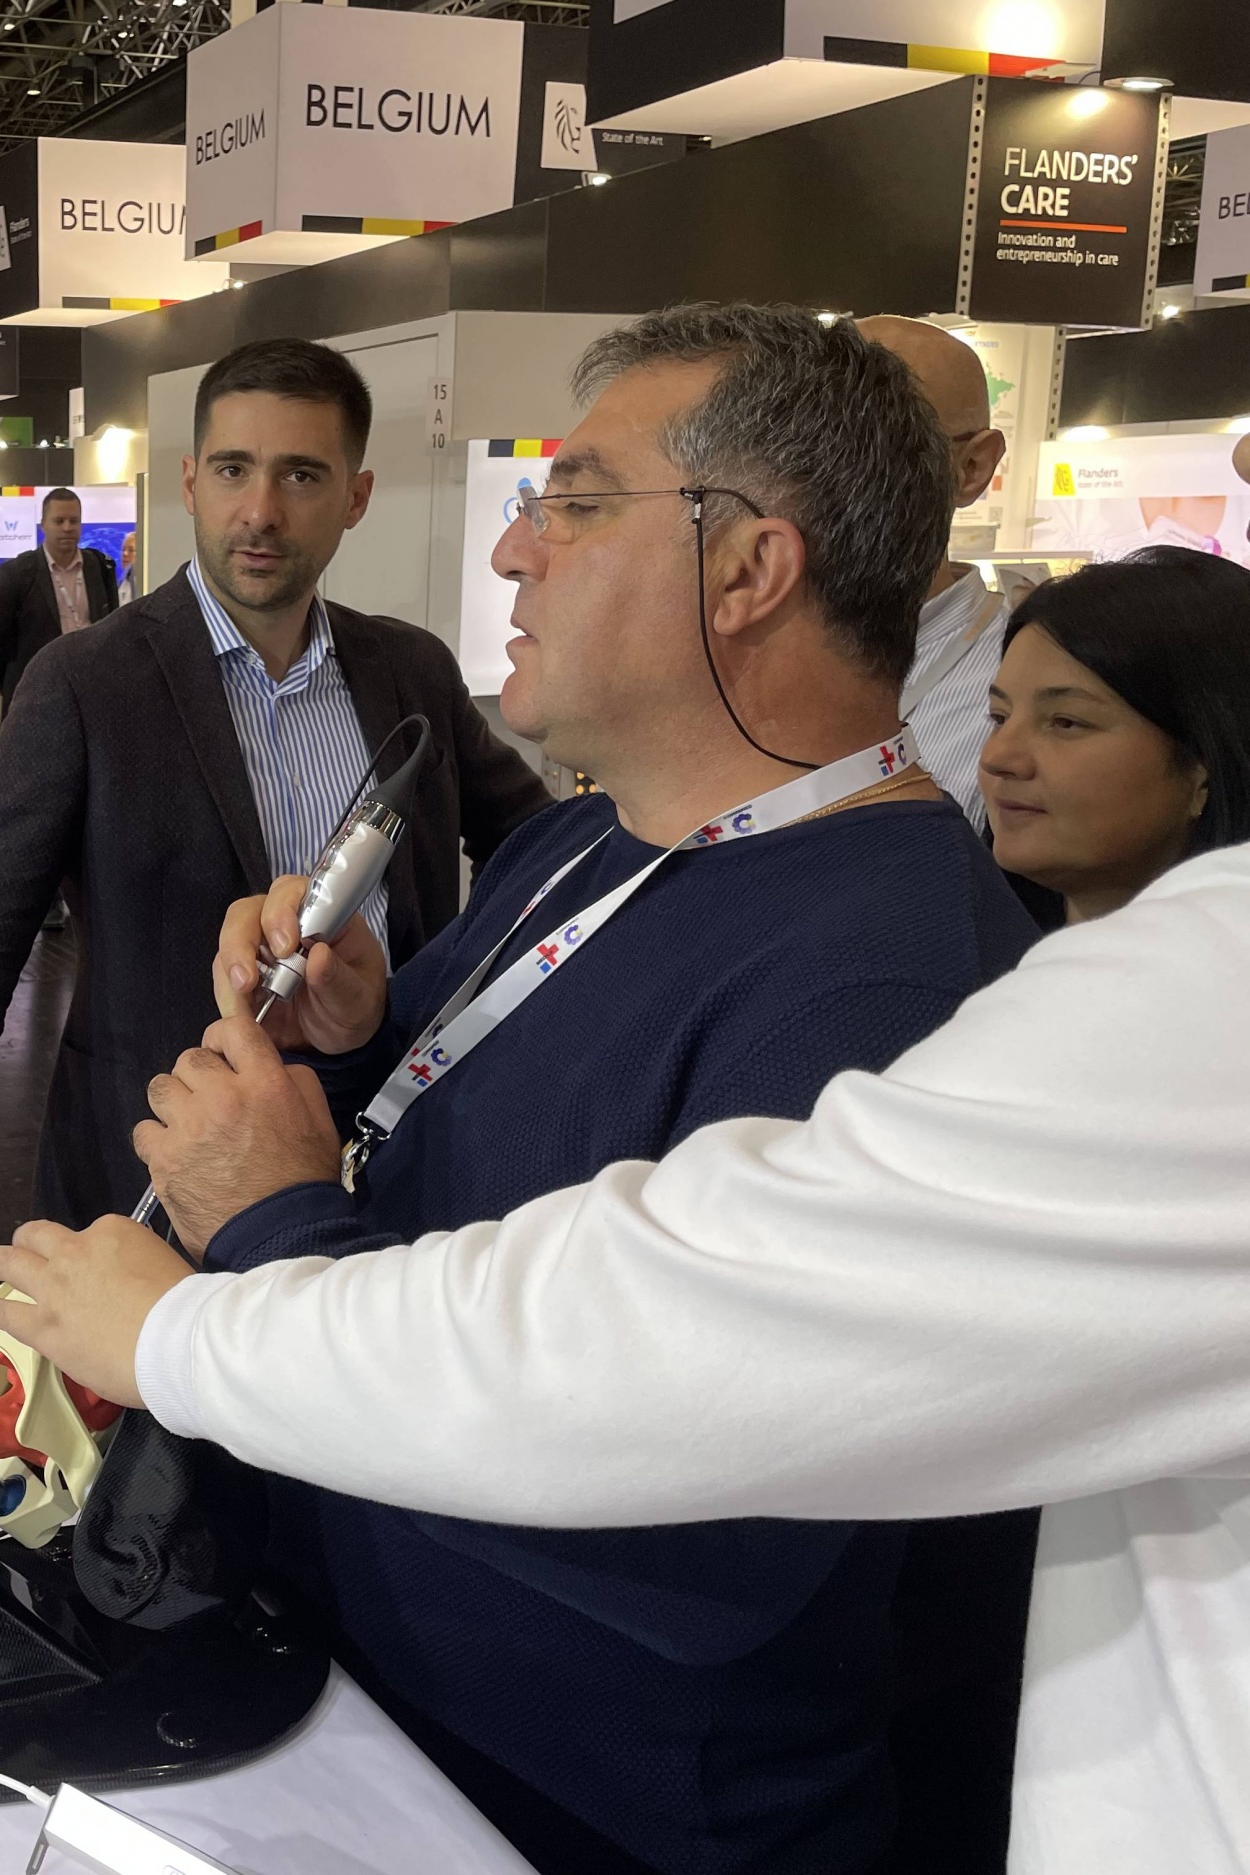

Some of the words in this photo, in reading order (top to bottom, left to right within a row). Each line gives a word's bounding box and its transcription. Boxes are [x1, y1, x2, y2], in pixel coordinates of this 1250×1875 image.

[305, 83, 491, 138] BELGIUM
[195, 108, 266, 165] BELGIUM
[1004, 147, 1139, 185] FLANDERS'
[1000, 184, 1071, 217] CARE
[998, 232, 1054, 248] Innovation
[1055, 234, 1077, 248] and
[996, 248, 1084, 267] entrepreneurship
[1085, 251, 1096, 264] in
[1097, 254, 1120, 266] care
[434, 384, 447, 400] 15
[434, 408, 443, 425] A
[432, 433, 446, 449] 10
[1078, 467, 1119, 479] Flanders
